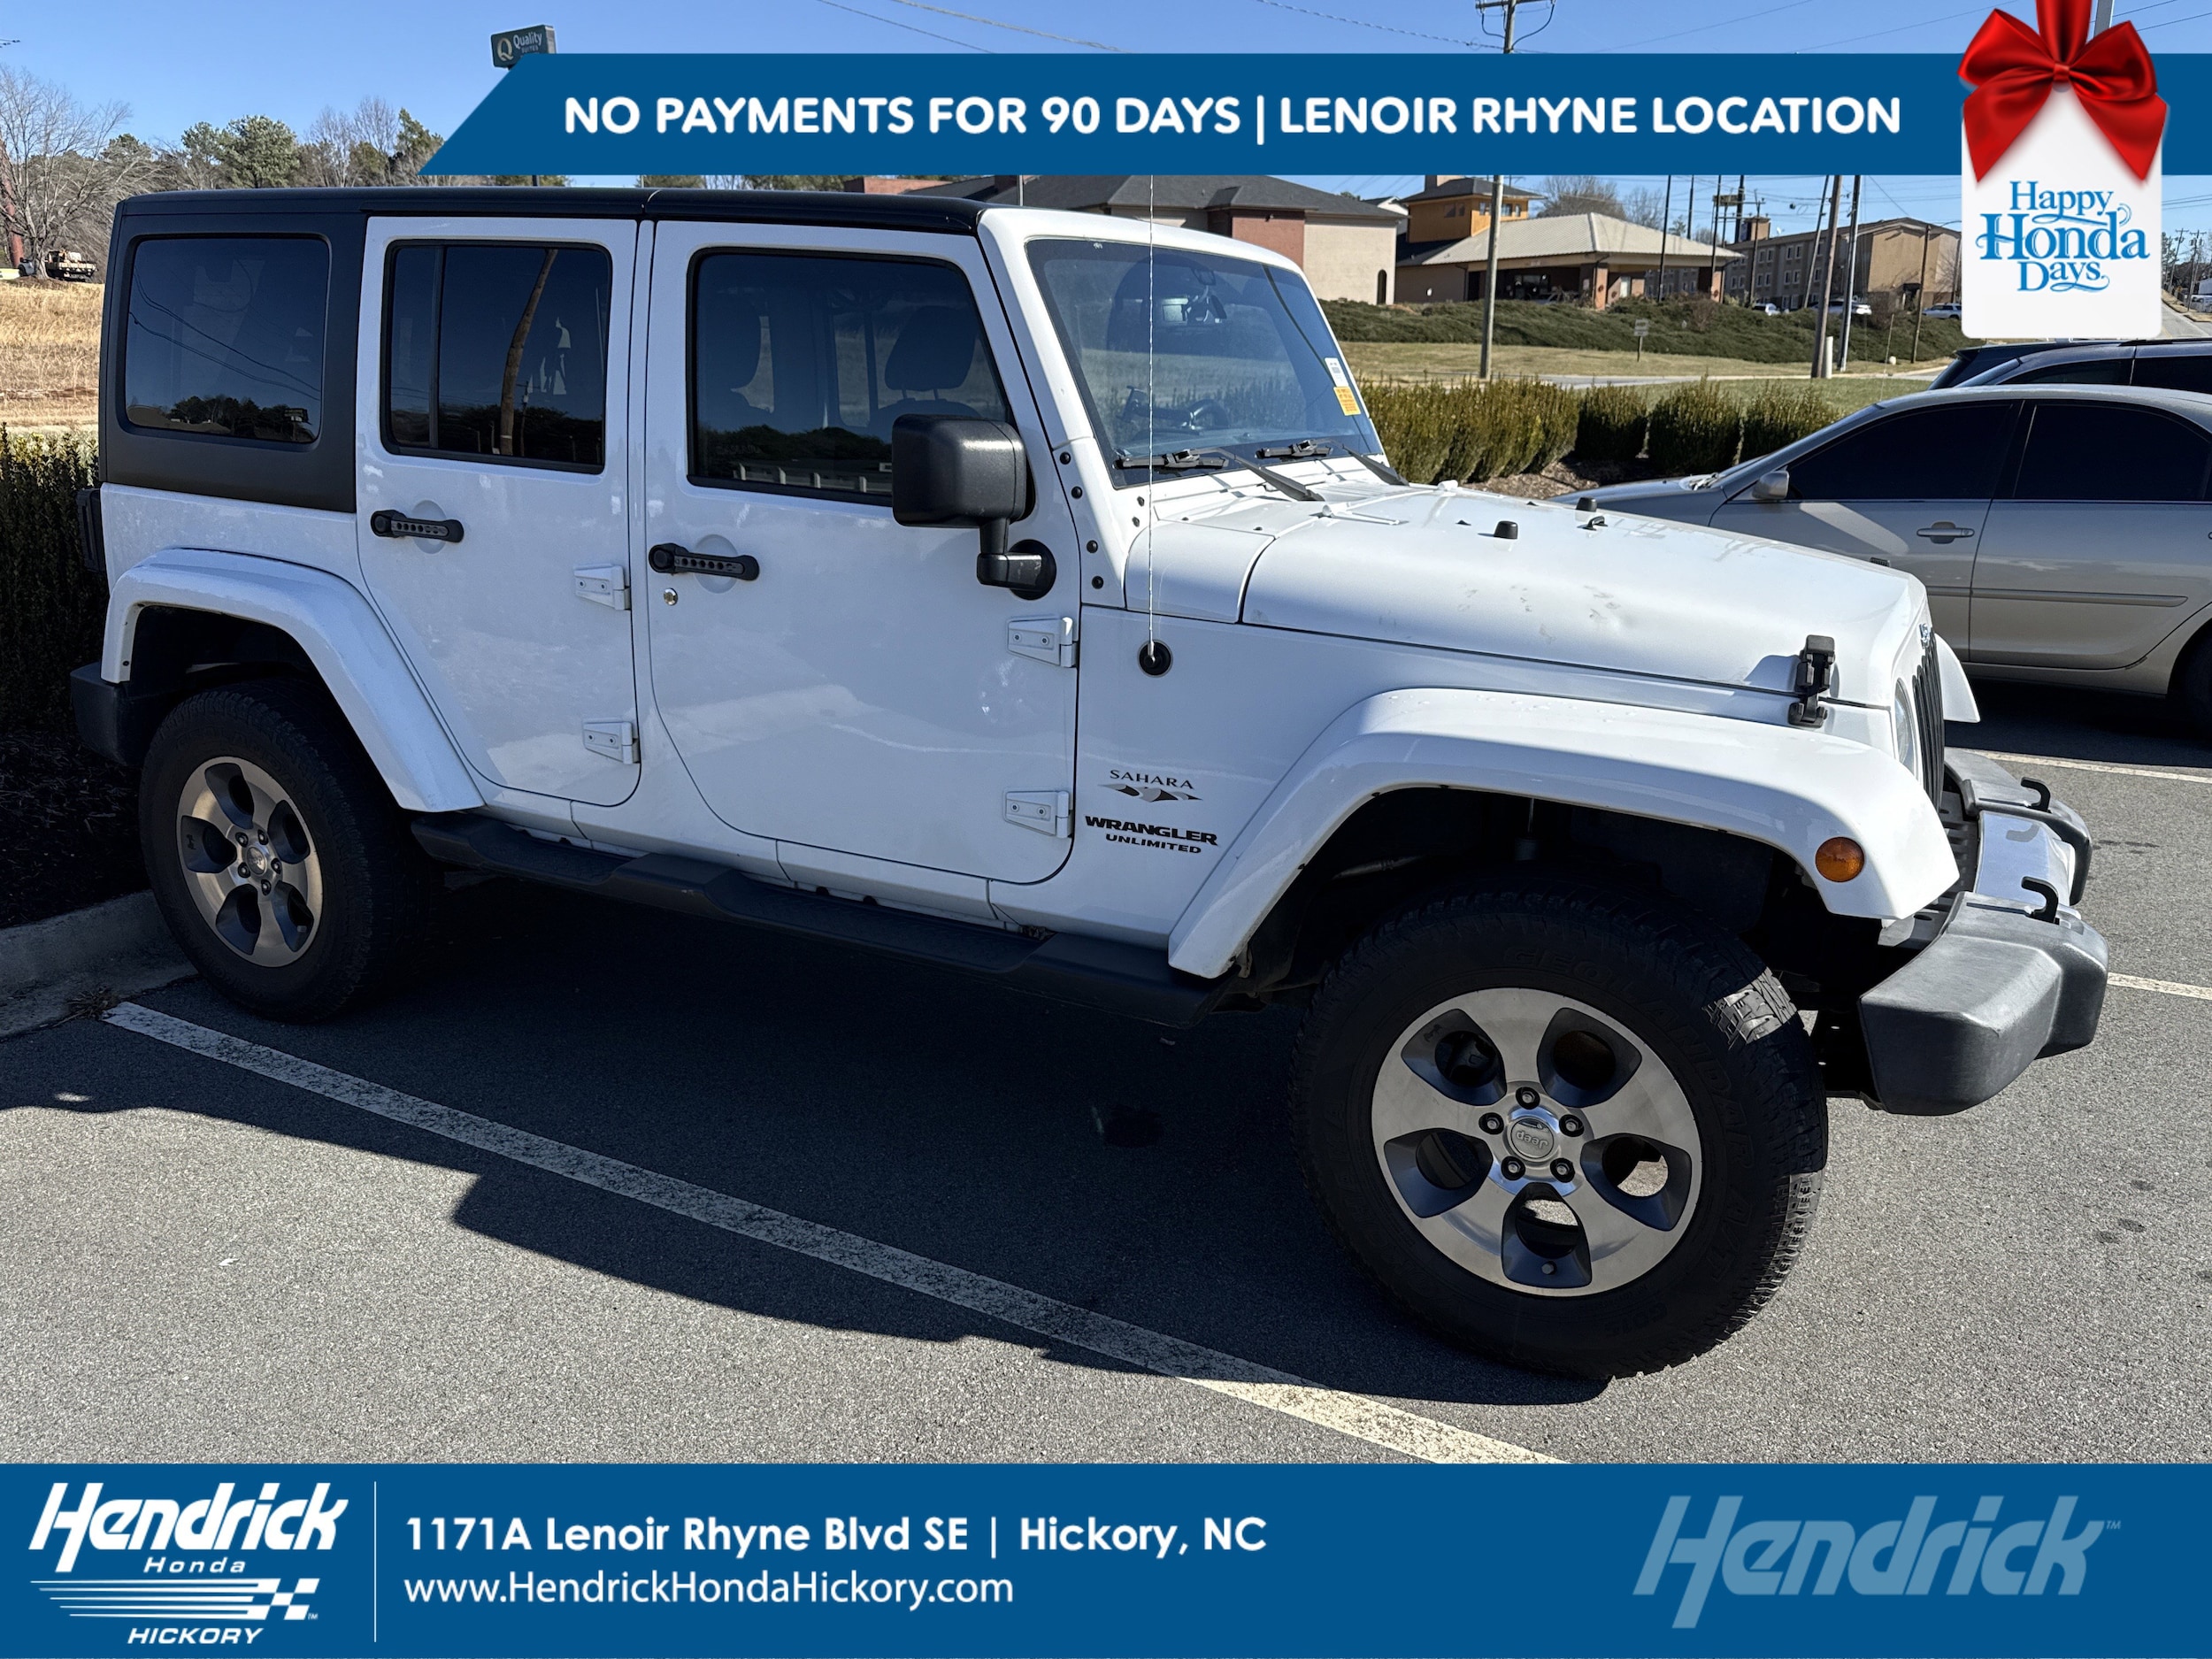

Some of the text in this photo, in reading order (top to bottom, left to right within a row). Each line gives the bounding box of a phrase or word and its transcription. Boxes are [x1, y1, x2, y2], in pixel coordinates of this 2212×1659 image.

[513, 31, 542, 50] Quality
[1110, 769, 1194, 790] SAHARA
[1085, 815, 1218, 846] WRANGLER
[1105, 833, 1202, 854] UNLIMITED
[1516, 1130, 1548, 1148] Jeep
